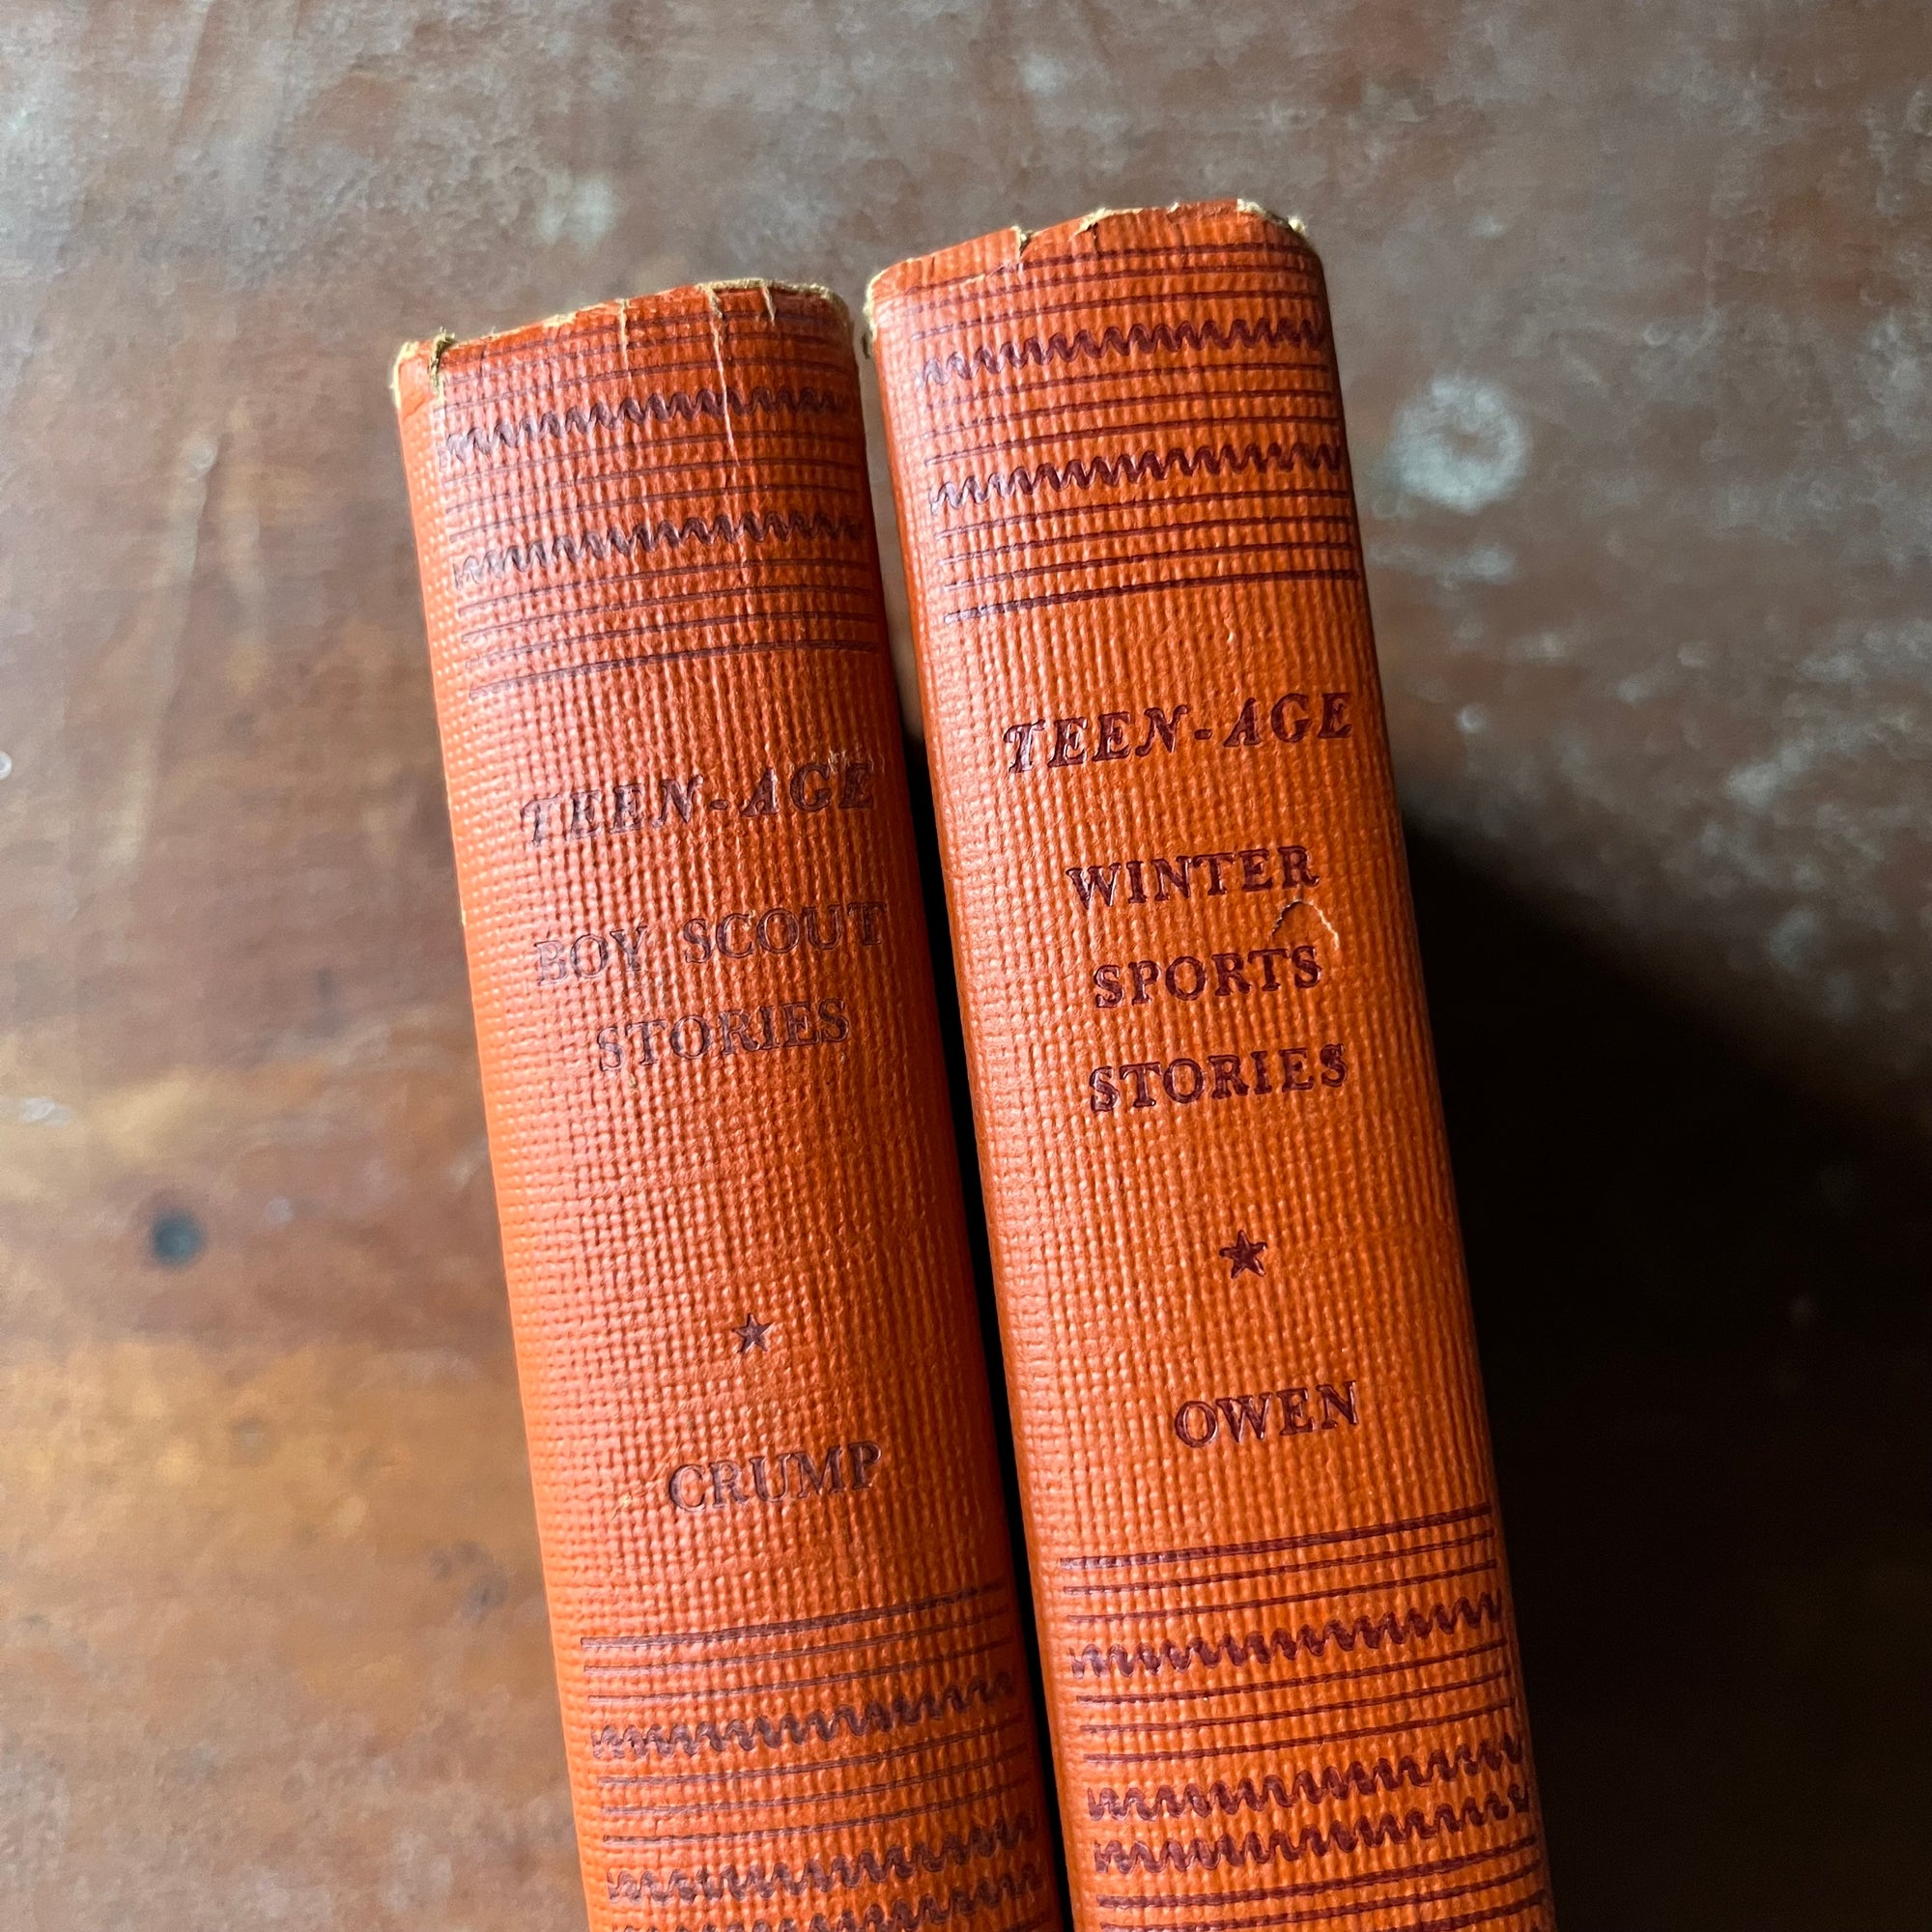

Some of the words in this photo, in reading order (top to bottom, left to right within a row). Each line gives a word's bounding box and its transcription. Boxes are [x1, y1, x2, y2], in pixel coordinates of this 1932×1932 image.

[1003, 692, 1353, 774] TEEN-AGE
[520, 761, 874, 847] TEEN-AGE
[1065, 845, 1320, 909] WINTER
[534, 926, 648, 986] BOY
[682, 902, 888, 964] SCOUT
[1093, 946, 1322, 1009] SPORTS
[597, 998, 850, 1071] STORIES
[1089, 1043, 1348, 1112] STORIES
[1174, 1379, 1359, 1448] OWEN
[668, 1440, 883, 1513] CRUMP
